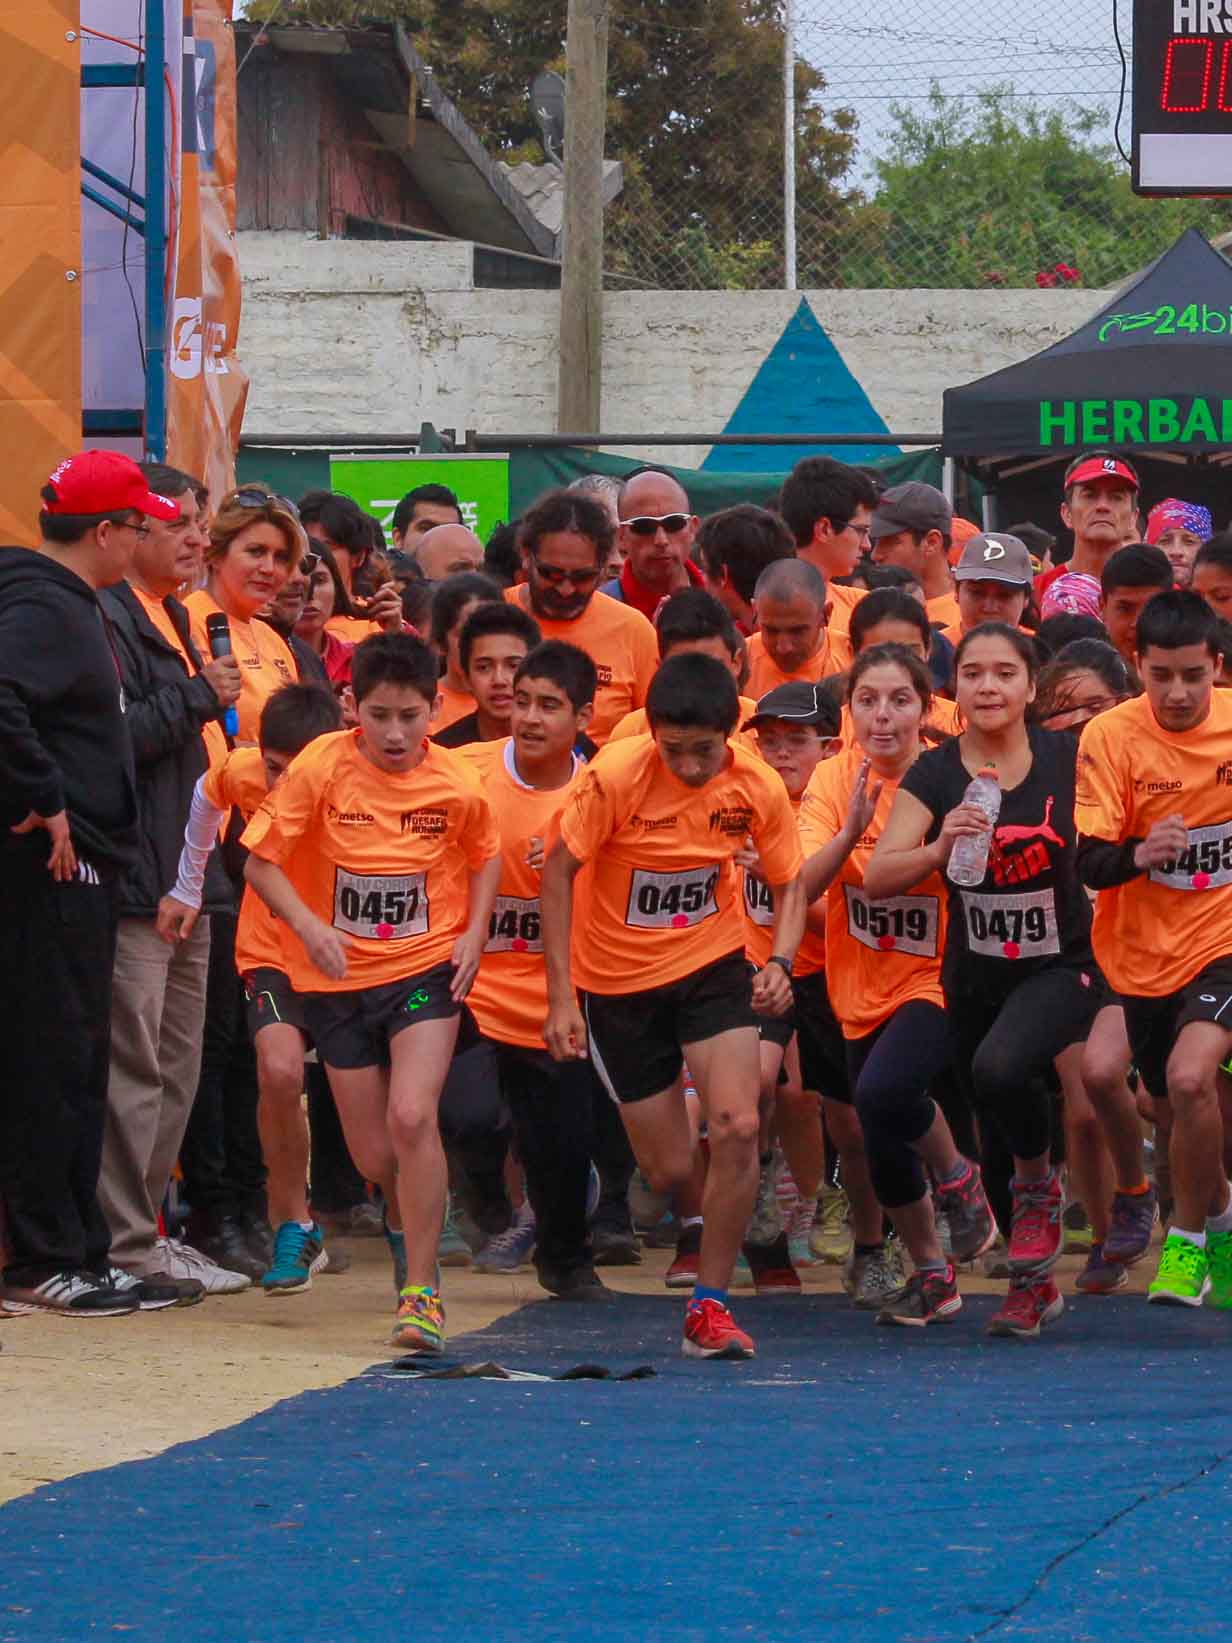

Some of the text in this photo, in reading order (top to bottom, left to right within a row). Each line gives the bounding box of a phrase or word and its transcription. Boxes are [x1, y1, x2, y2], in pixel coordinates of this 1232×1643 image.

[1148, 781, 1182, 791] metso
[339, 813, 374, 821] metso
[341, 886, 419, 925] 0457
[852, 897, 927, 941] 0519
[969, 905, 1048, 944] 0479
